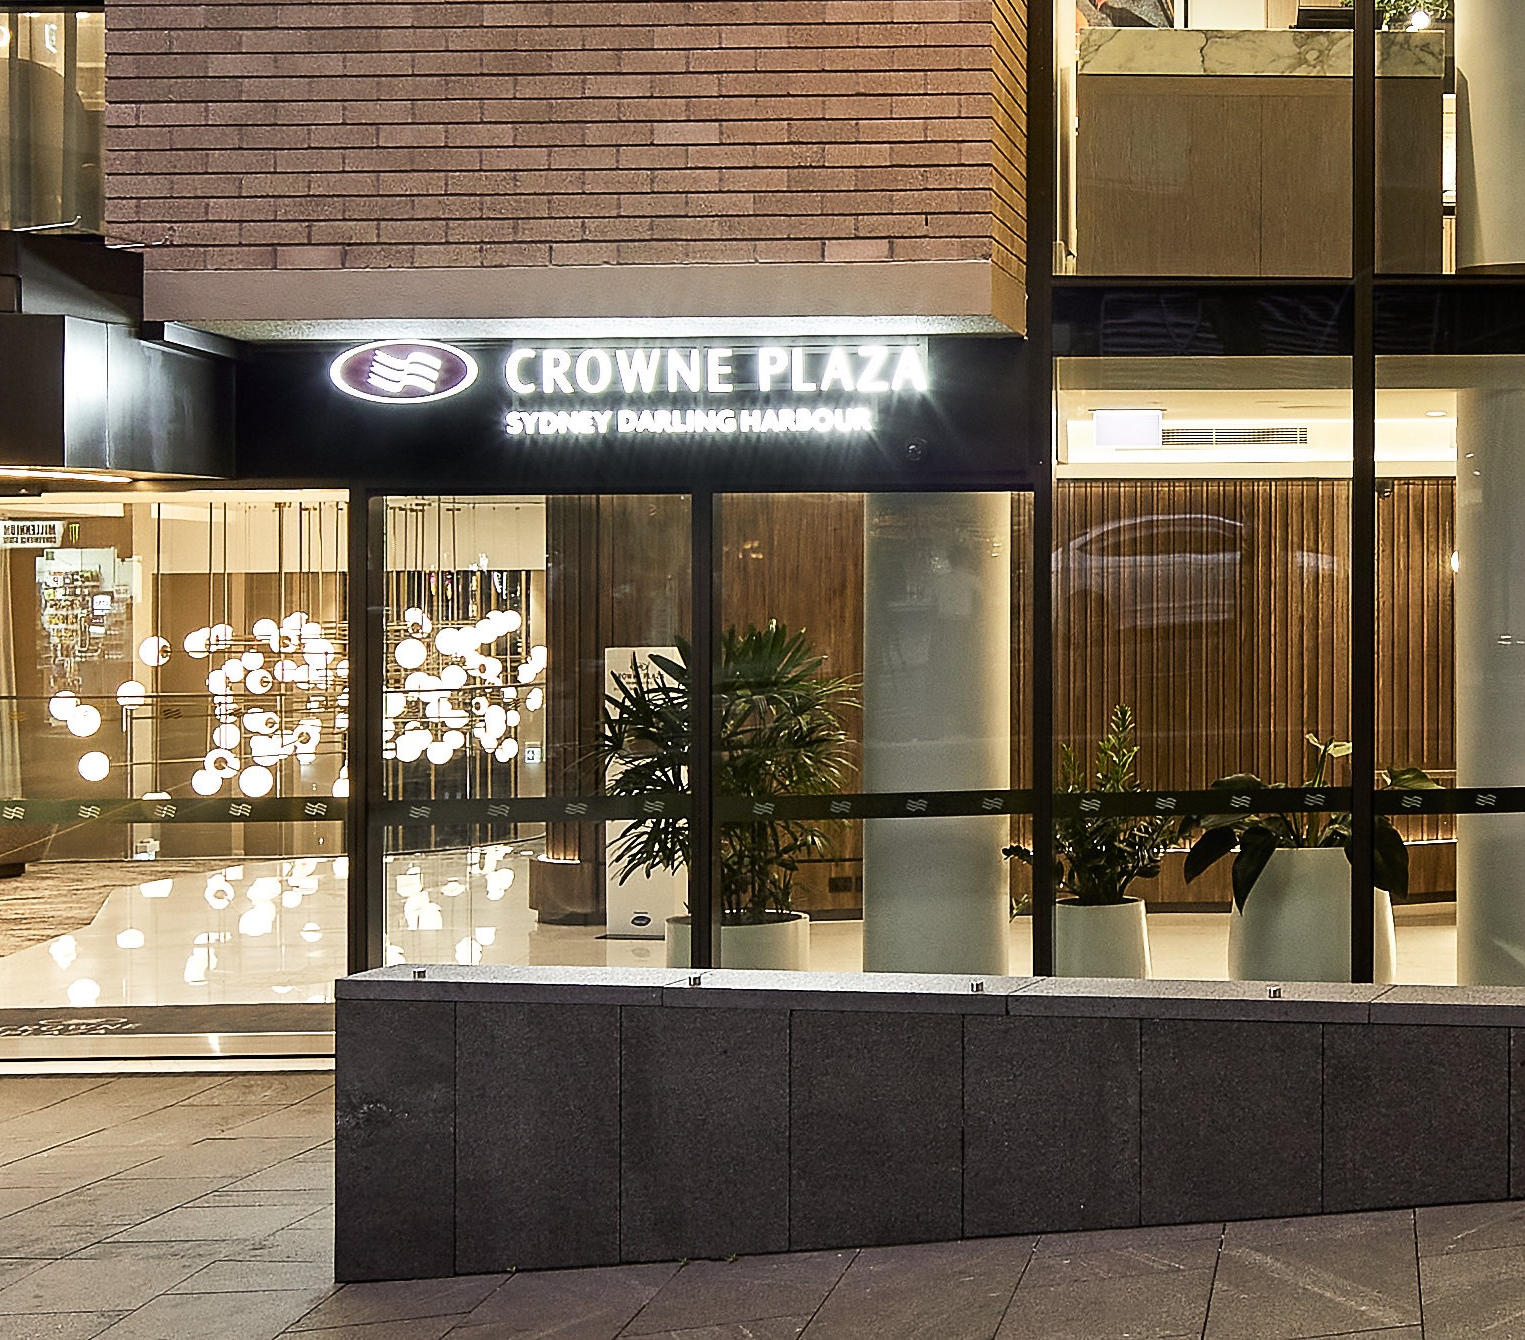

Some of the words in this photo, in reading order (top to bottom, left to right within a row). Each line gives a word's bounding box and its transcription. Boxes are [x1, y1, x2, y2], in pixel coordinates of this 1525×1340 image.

[504, 348, 734, 394] CROWNE
[758, 345, 929, 392] PLAZA
[505, 410, 613, 435] SYDNEY
[617, 408, 737, 433] DARLING
[740, 407, 873, 433] HARBOUR
